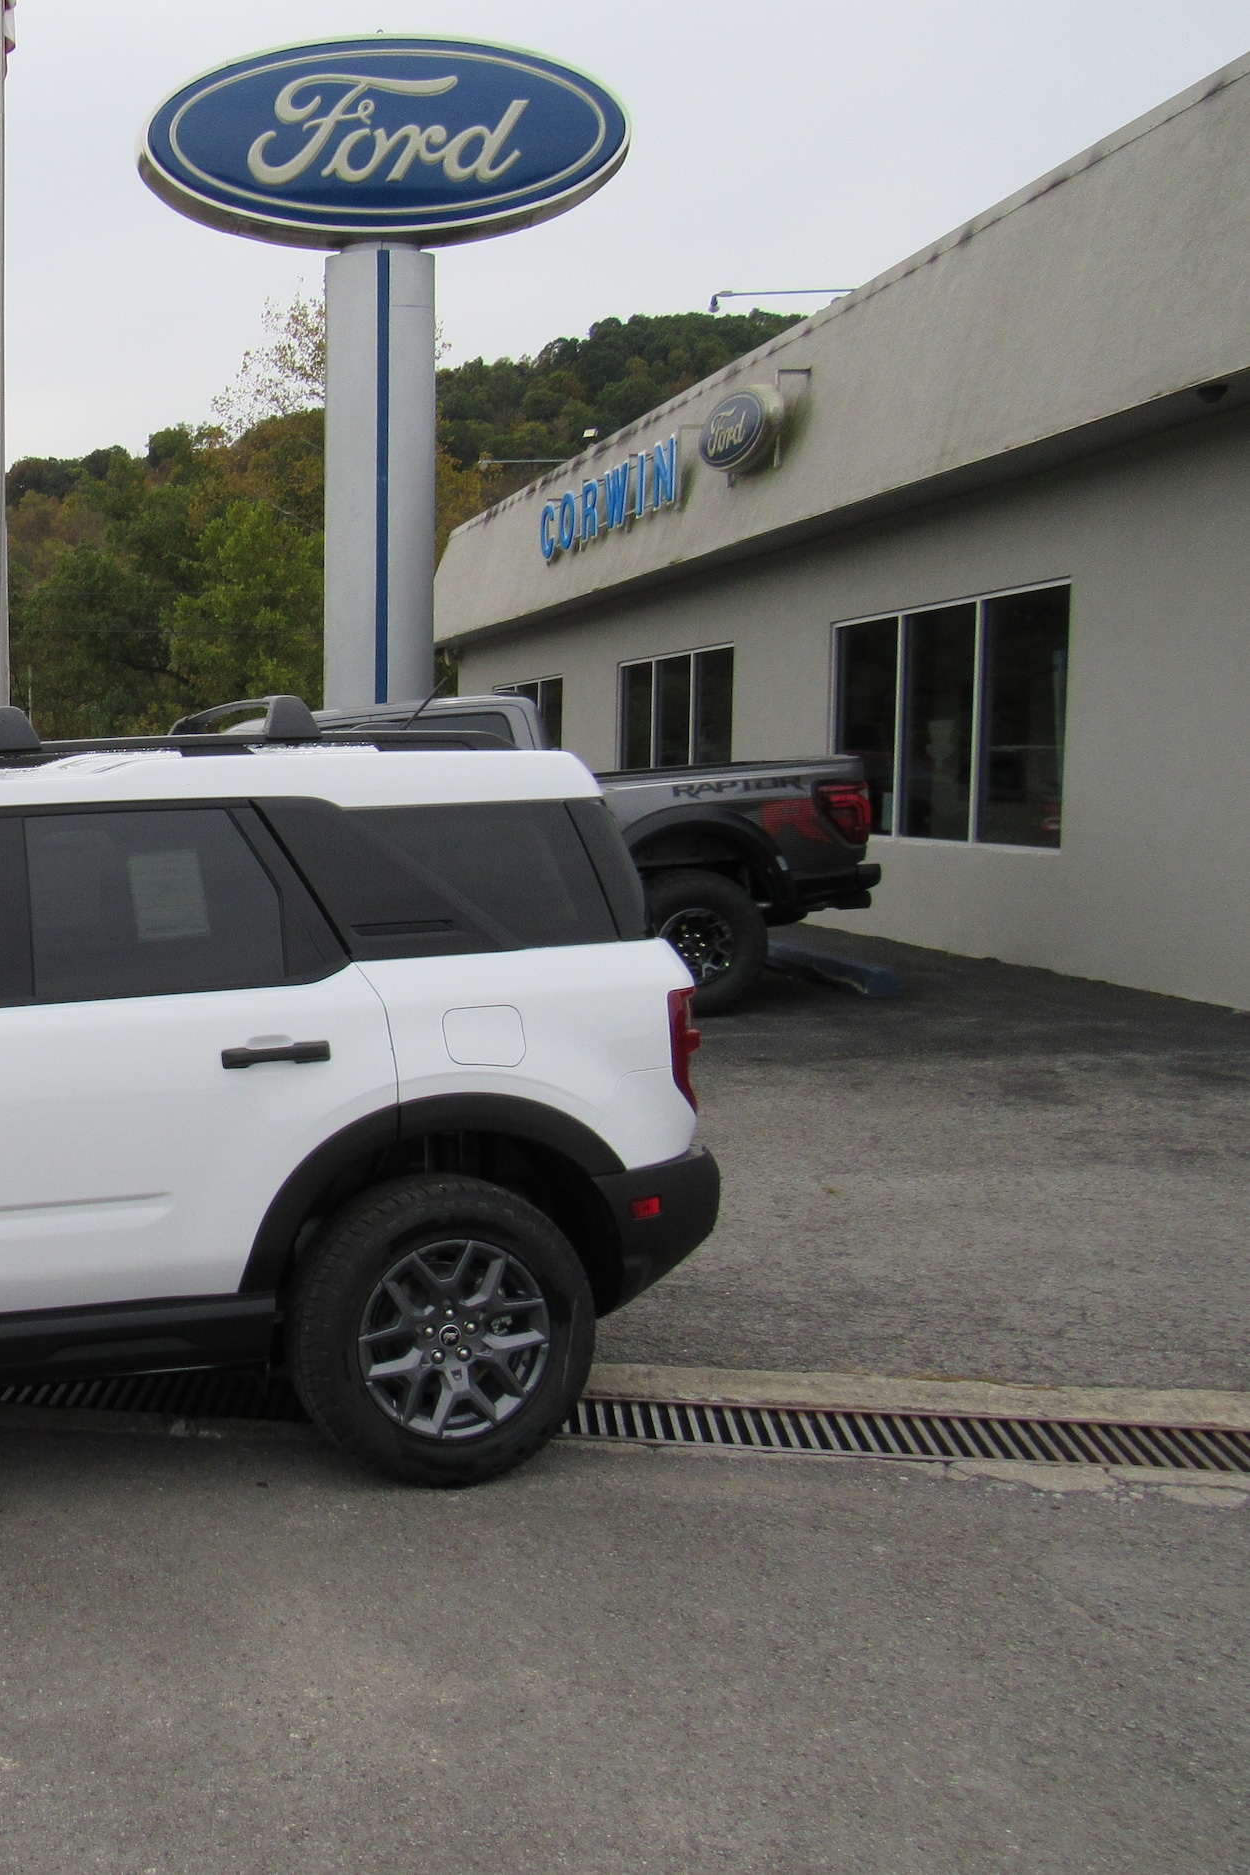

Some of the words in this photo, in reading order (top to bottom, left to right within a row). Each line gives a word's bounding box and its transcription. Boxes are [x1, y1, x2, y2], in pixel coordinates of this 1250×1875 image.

[246, 73, 529, 186] Ford
[707, 405, 747, 458] Ford
[539, 432, 678, 560] CORWIN
[672, 775, 806, 799] RAPTOR
